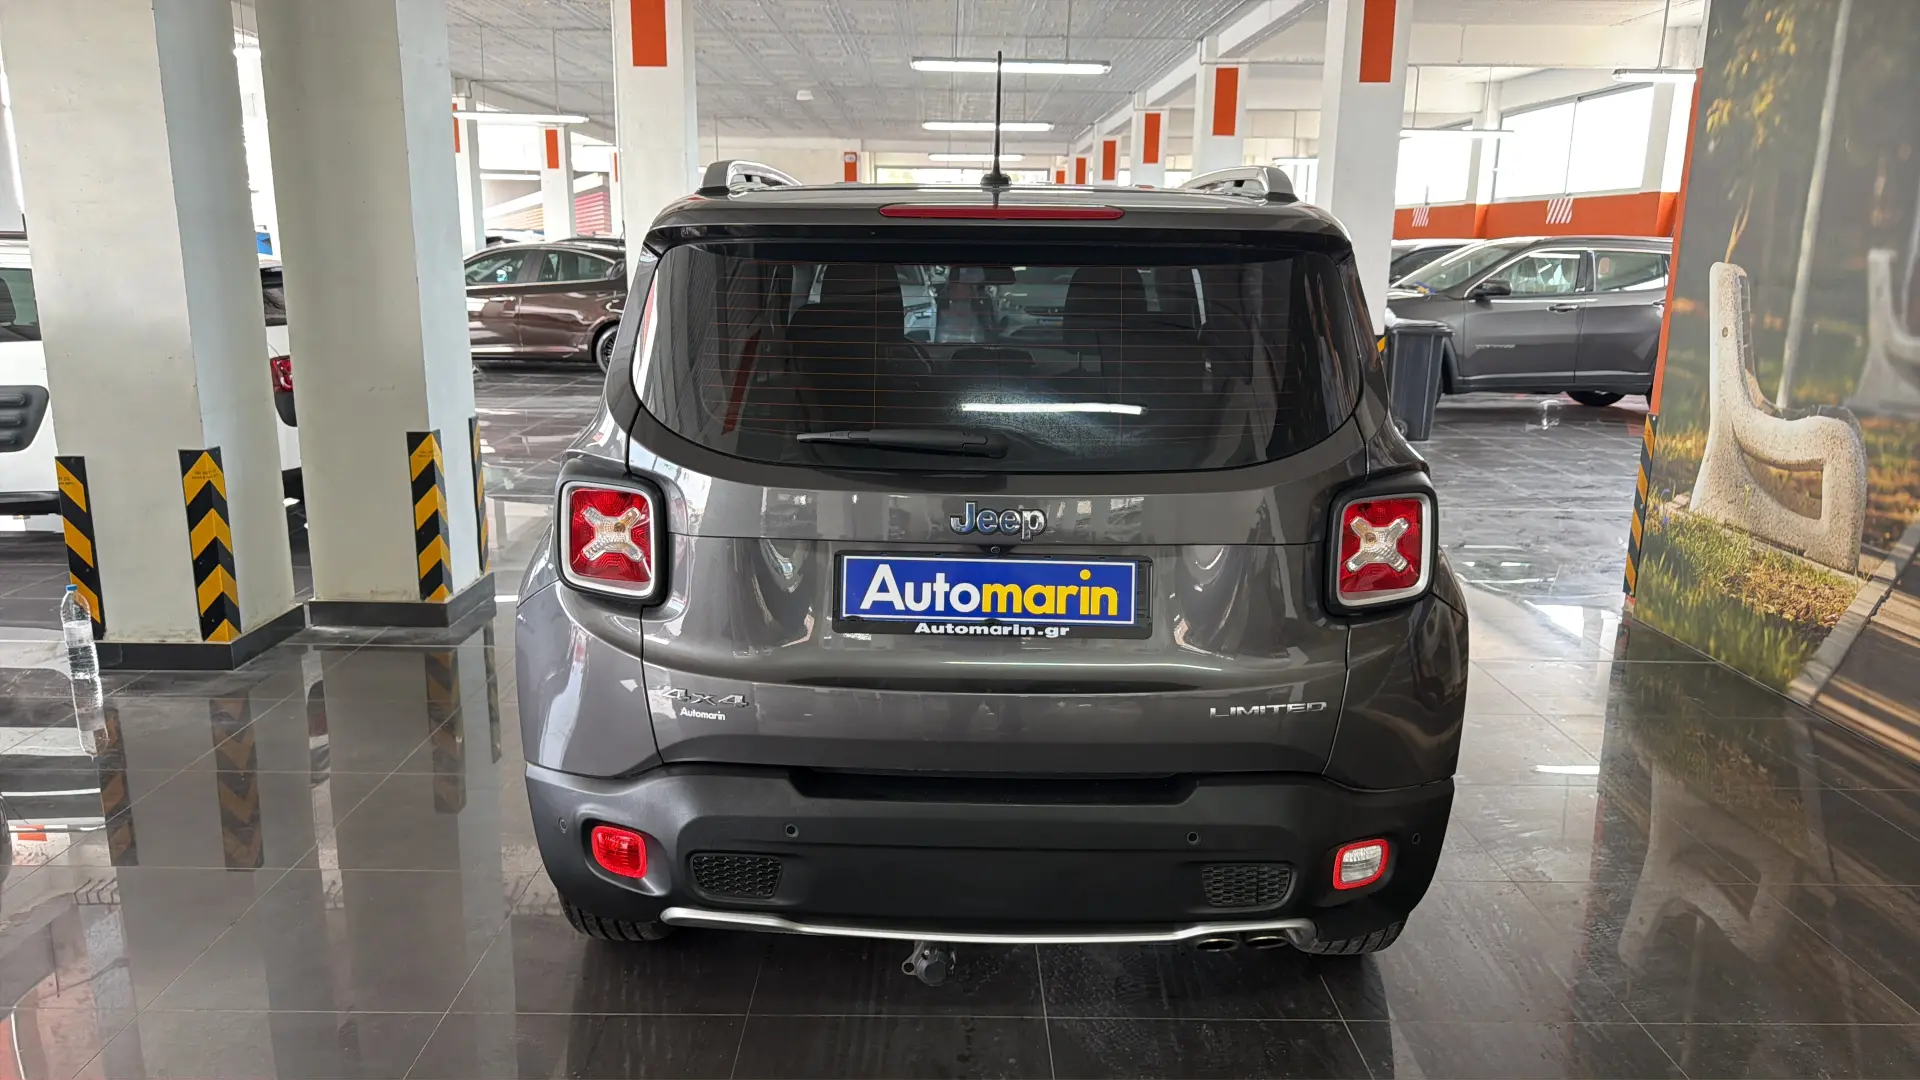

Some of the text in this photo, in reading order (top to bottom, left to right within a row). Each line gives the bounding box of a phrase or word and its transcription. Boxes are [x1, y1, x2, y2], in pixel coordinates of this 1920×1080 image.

[950, 501, 1047, 540] Jeep
[859, 563, 1118, 616] Automarin
[914, 622, 1070, 638] Automarin.gr
[679, 706, 726, 721] Automarin
[1209, 701, 1328, 718] LIMITED
